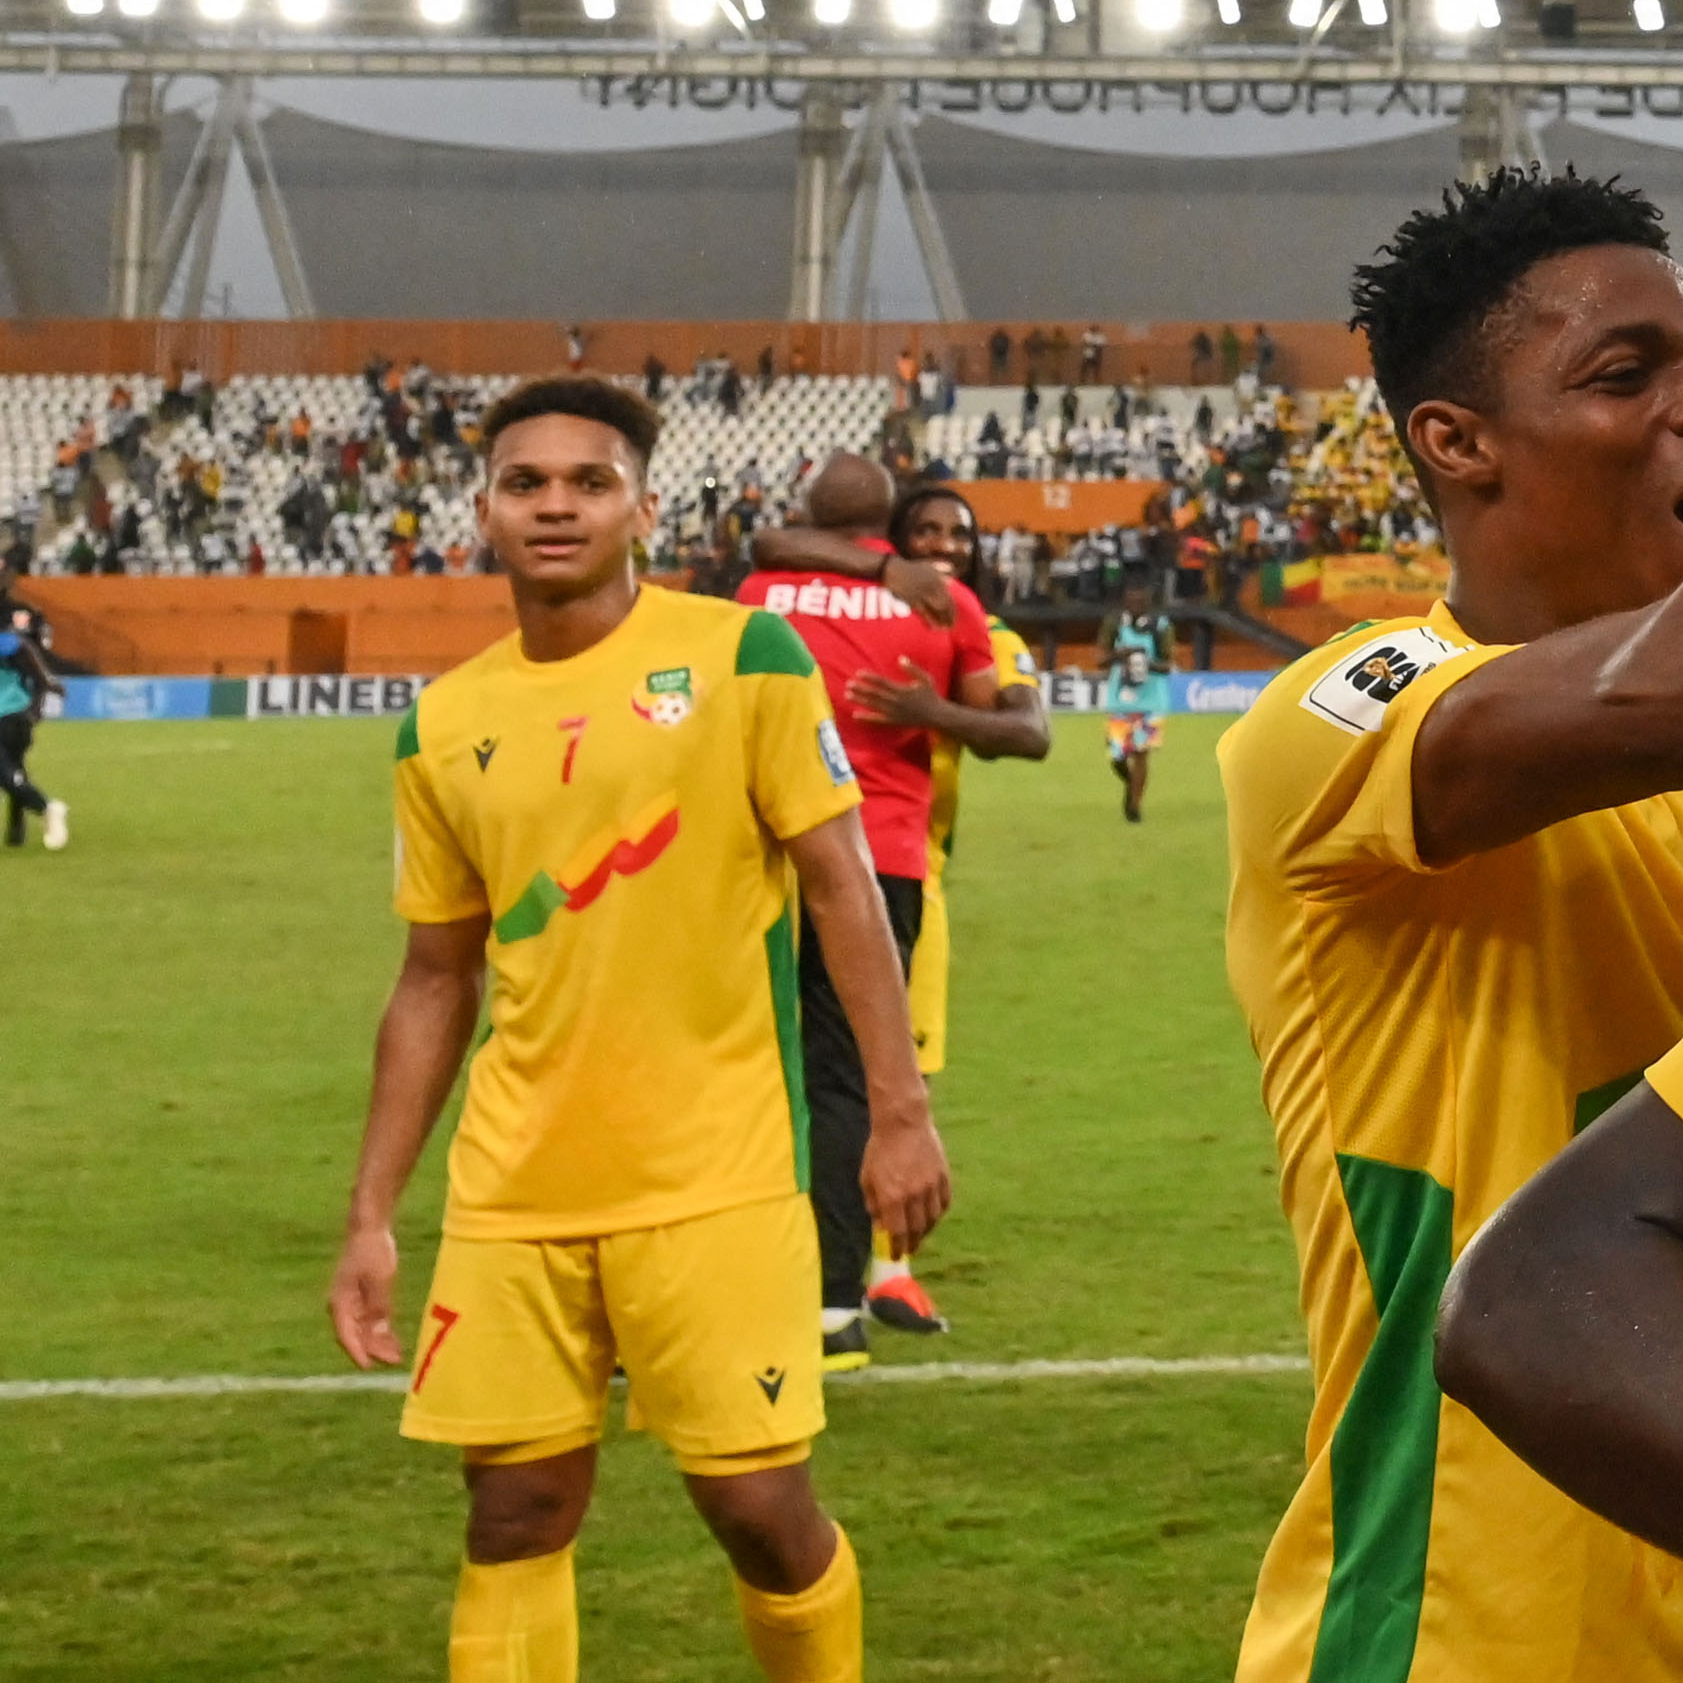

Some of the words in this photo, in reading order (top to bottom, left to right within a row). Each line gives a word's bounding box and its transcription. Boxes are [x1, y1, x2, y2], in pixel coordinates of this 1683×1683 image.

[258, 678, 430, 713] LINEB
[556, 715, 590, 785] 7
[413, 1304, 459, 1394] 7
